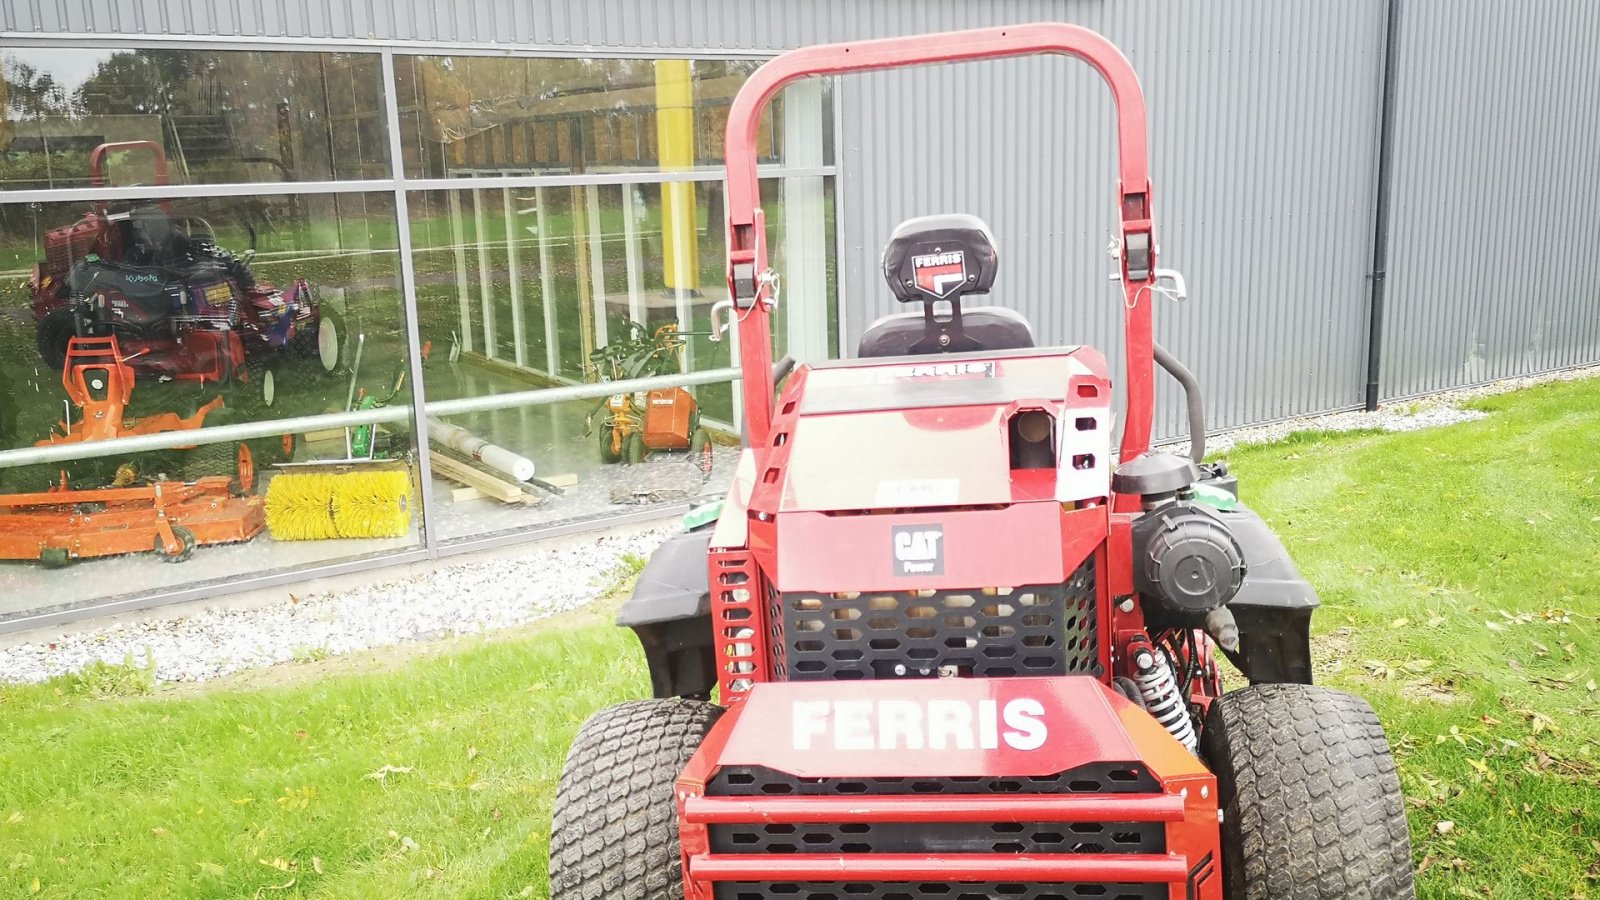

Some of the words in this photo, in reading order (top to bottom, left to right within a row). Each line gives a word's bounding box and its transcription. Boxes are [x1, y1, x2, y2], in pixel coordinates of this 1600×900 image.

[915, 252, 962, 267] FERRIS
[126, 274, 158, 282] Kubota
[895, 531, 941, 561] CAT
[903, 561, 934, 573] Power
[792, 698, 1048, 751] FERRIS
